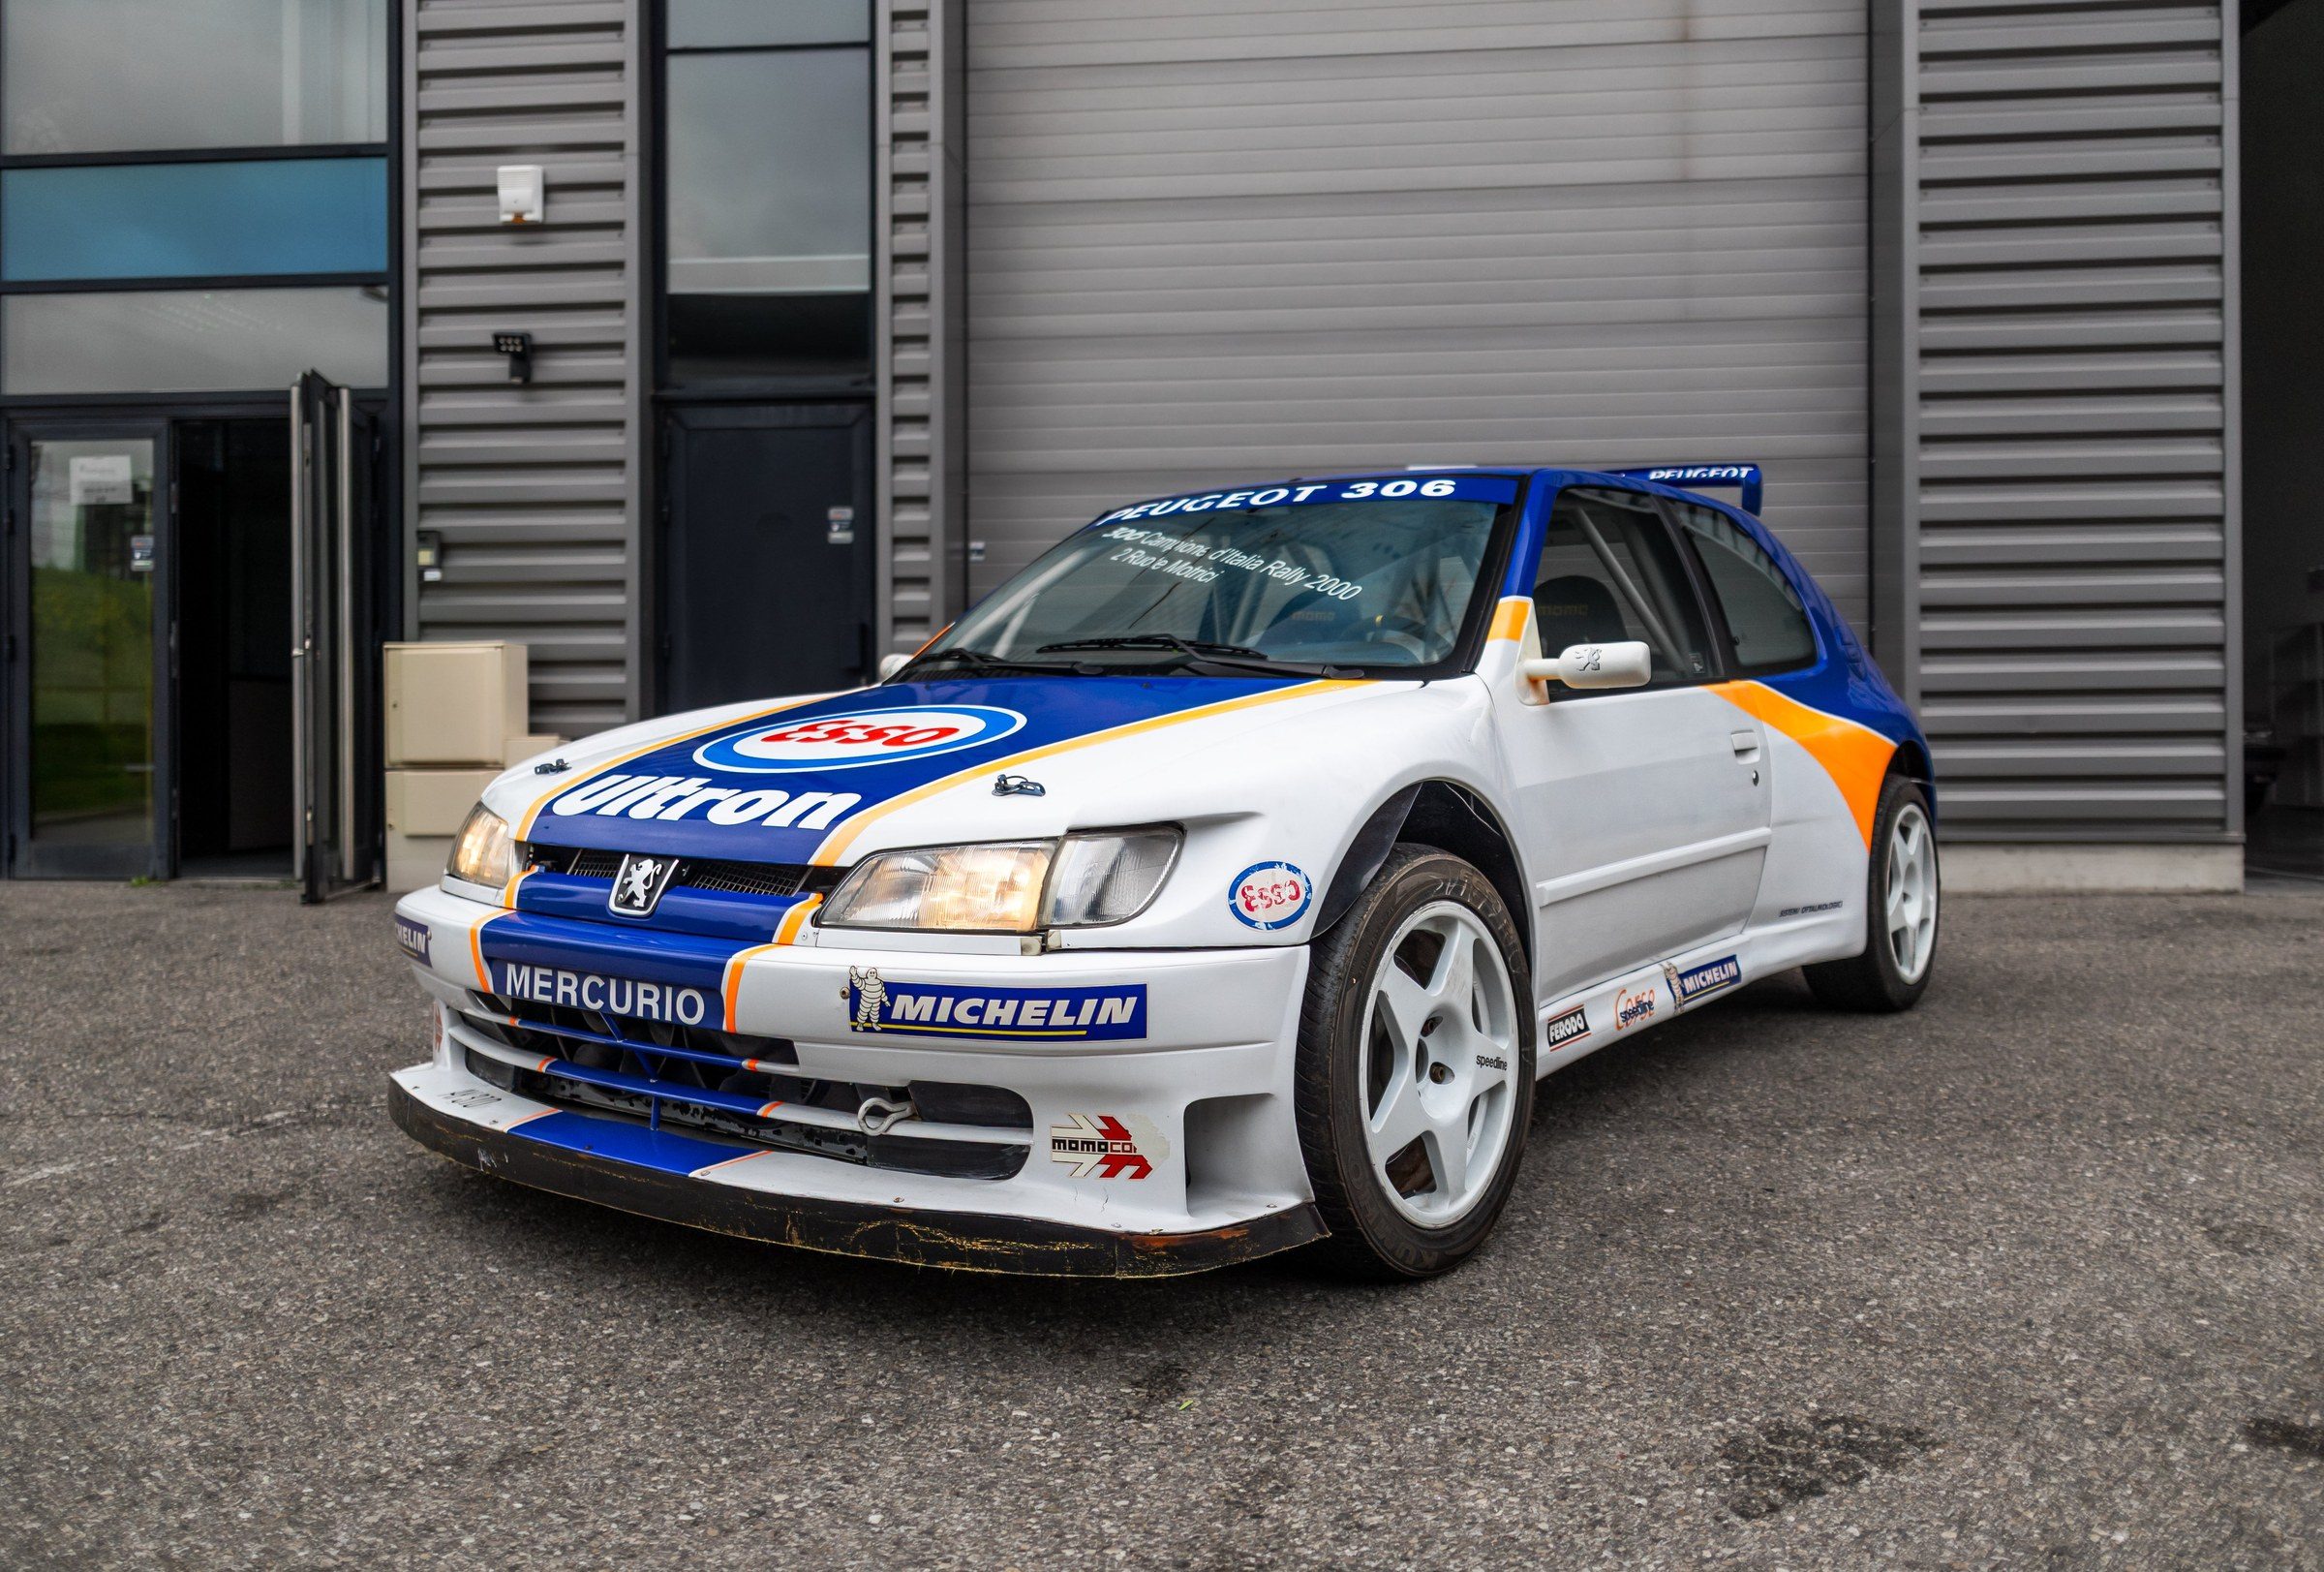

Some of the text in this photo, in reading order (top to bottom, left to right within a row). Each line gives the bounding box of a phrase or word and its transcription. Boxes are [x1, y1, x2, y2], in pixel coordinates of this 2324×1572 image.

[1095, 480, 1455, 526] PEUGEOT 306
[1101, 527, 1362, 601] 306 Campione d'Italia Rally 2000
[1110, 547, 1133, 561] 2
[1162, 559, 1225, 583] Motrici
[505, 963, 705, 1026] MERCURIO
[1683, 961, 1738, 995] MICHELIN
[890, 994, 1138, 1027] MICHELIN
[1549, 1012, 1585, 1043] FERODO
[1476, 1055, 1508, 1071] speedline
